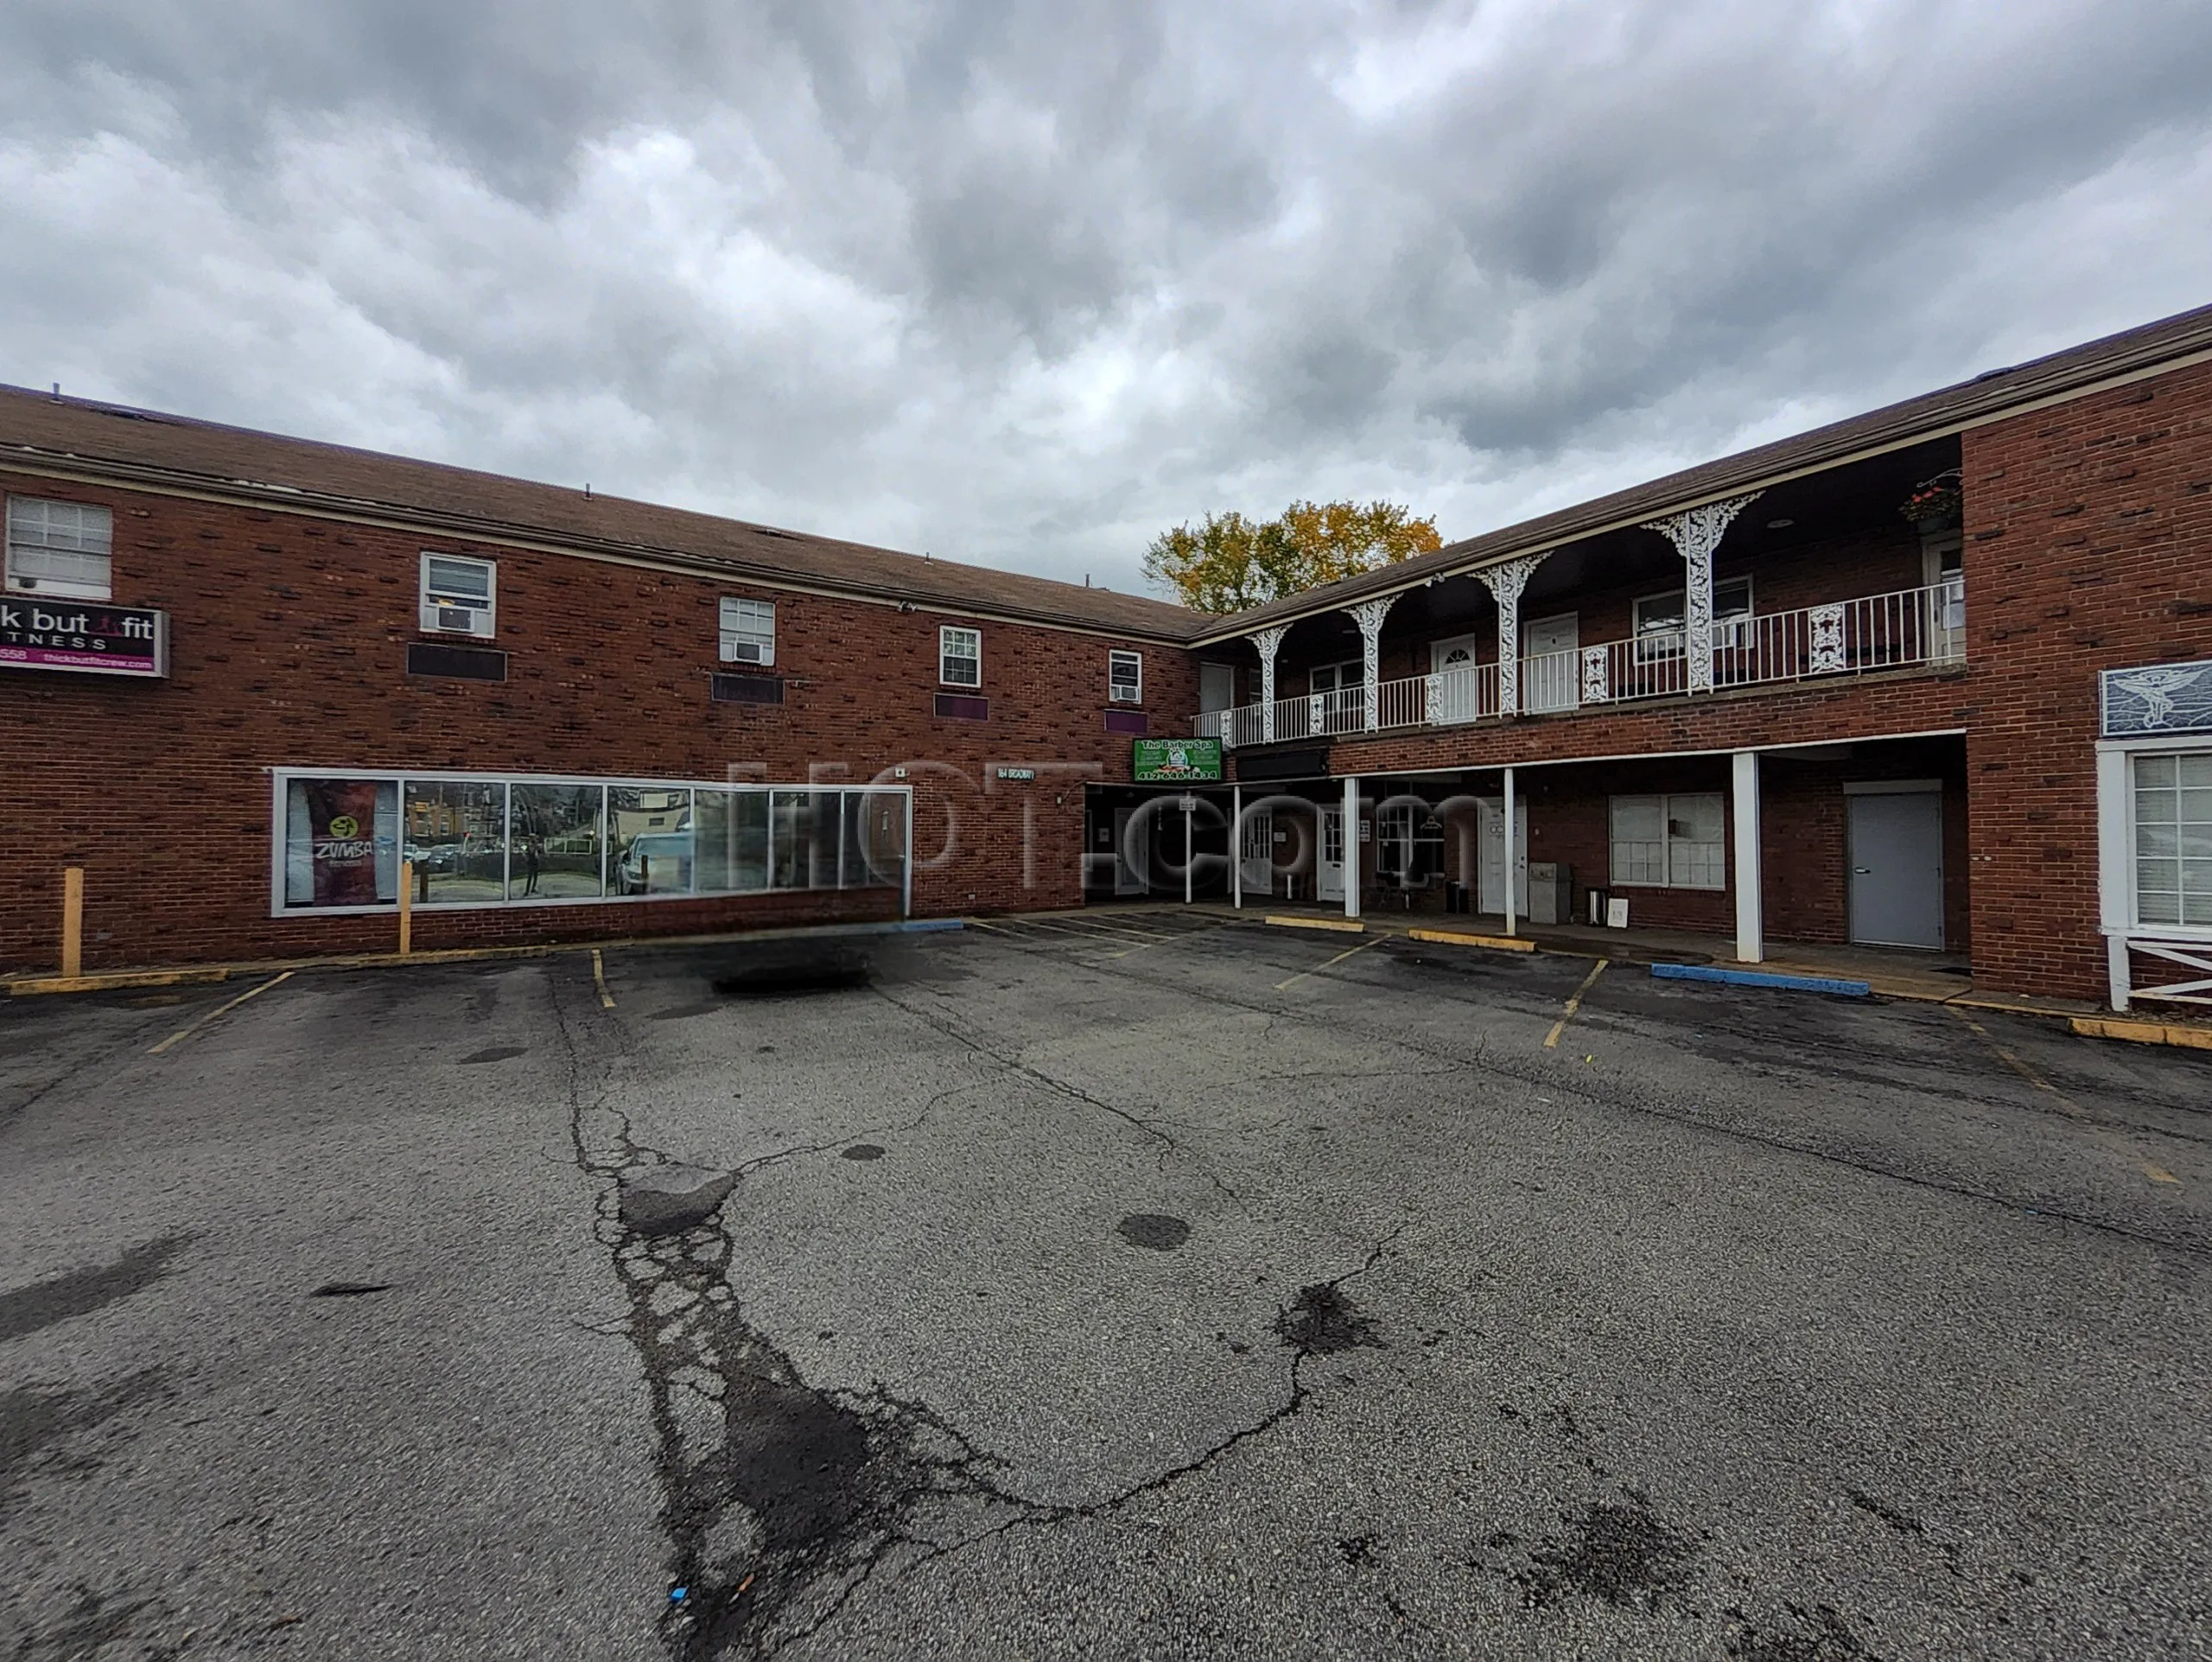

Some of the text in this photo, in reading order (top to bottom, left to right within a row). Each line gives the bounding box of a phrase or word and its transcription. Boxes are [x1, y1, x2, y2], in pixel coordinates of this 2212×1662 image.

[33, 608, 90, 634] but
[121, 616, 153, 640] fit
[1142, 739, 1213, 750] The Barber Spa
[315, 841, 372, 858] ZUMBA
